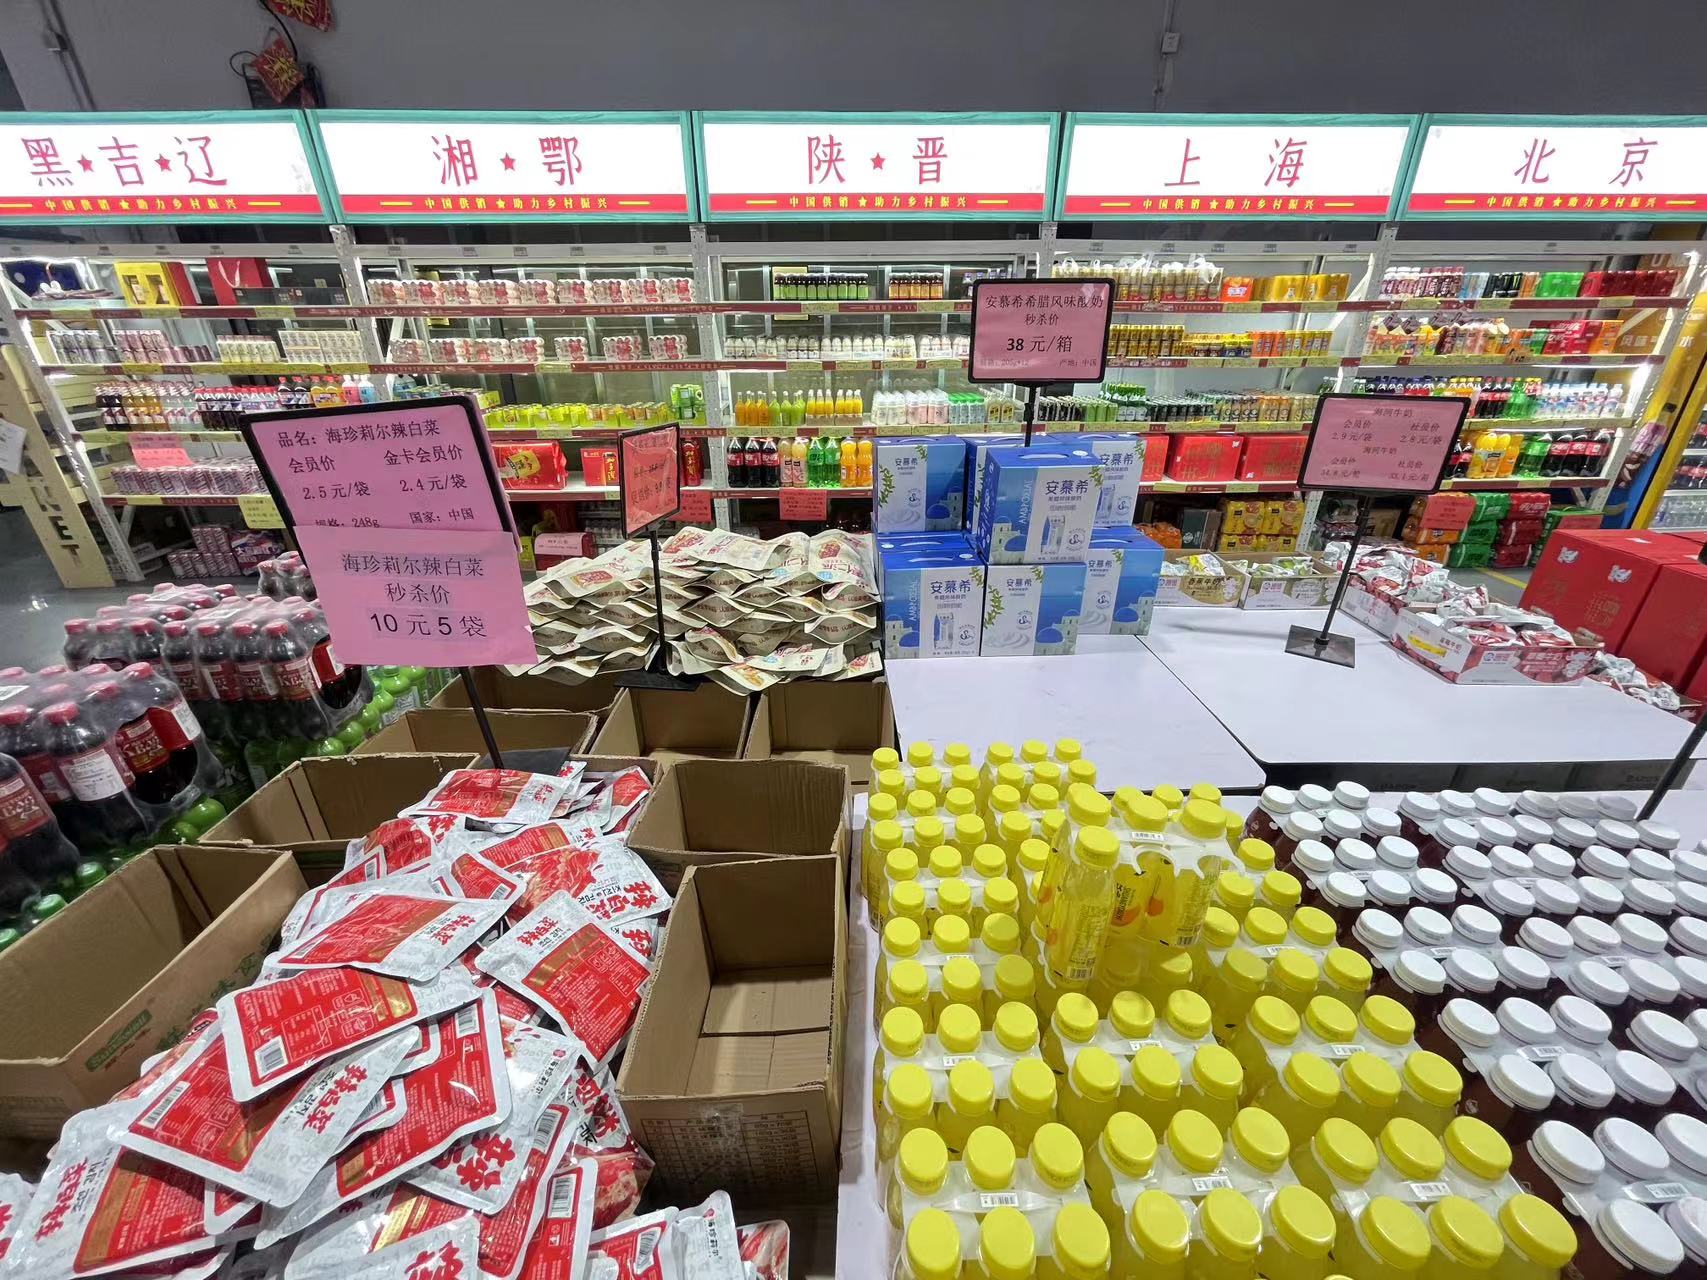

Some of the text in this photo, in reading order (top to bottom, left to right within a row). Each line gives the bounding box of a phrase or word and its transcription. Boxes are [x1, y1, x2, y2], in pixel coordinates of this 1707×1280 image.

[21, 135, 228, 187] 黑 吉 辽
[430, 134, 583, 187] 湘 鄂
[806, 134, 948, 185] 陕 晋
[1164, 137, 1308, 188] 上海
[1513, 137, 1659, 188] 北京
[424, 197, 608, 210] 中国供销 助力乡村振兴
[789, 196, 968, 209] 中国供销 助力乡村振兴
[1142, 198, 1315, 211] 中国供销 助力乡村振兴
[985, 294, 1104, 309] 安慕希希腊风味酸奶
[1024, 313, 1059, 326] 秒杀价
[1006, 335, 1073, 353] 38 元/箱
[1343, 420, 1373, 429] 会员价
[288, 444, 464, 474] 会员价 金卡会员价
[895, 457, 918, 467] 安慕希
[1100, 453, 1134, 466] 安慕希
[302, 473, 468, 500] 2.5元/袋 2.4元/袋
[1045, 480, 1089, 495] 安慕希
[341, 553, 485, 578] 海珍莉尔辣白菜
[1088, 559, 1113, 568] 安慕希
[931, 579, 971, 594] 安慕希
[1006, 578, 1032, 587] 安慕希
[384, 583, 450, 605] 秒杀价
[370, 612, 488, 638] 10 元 5 袋
[516, 915, 560, 948] 辣白菜
[303, 1064, 368, 1135] 辣白菜
[34, 1156, 89, 1242] 辣白菜
